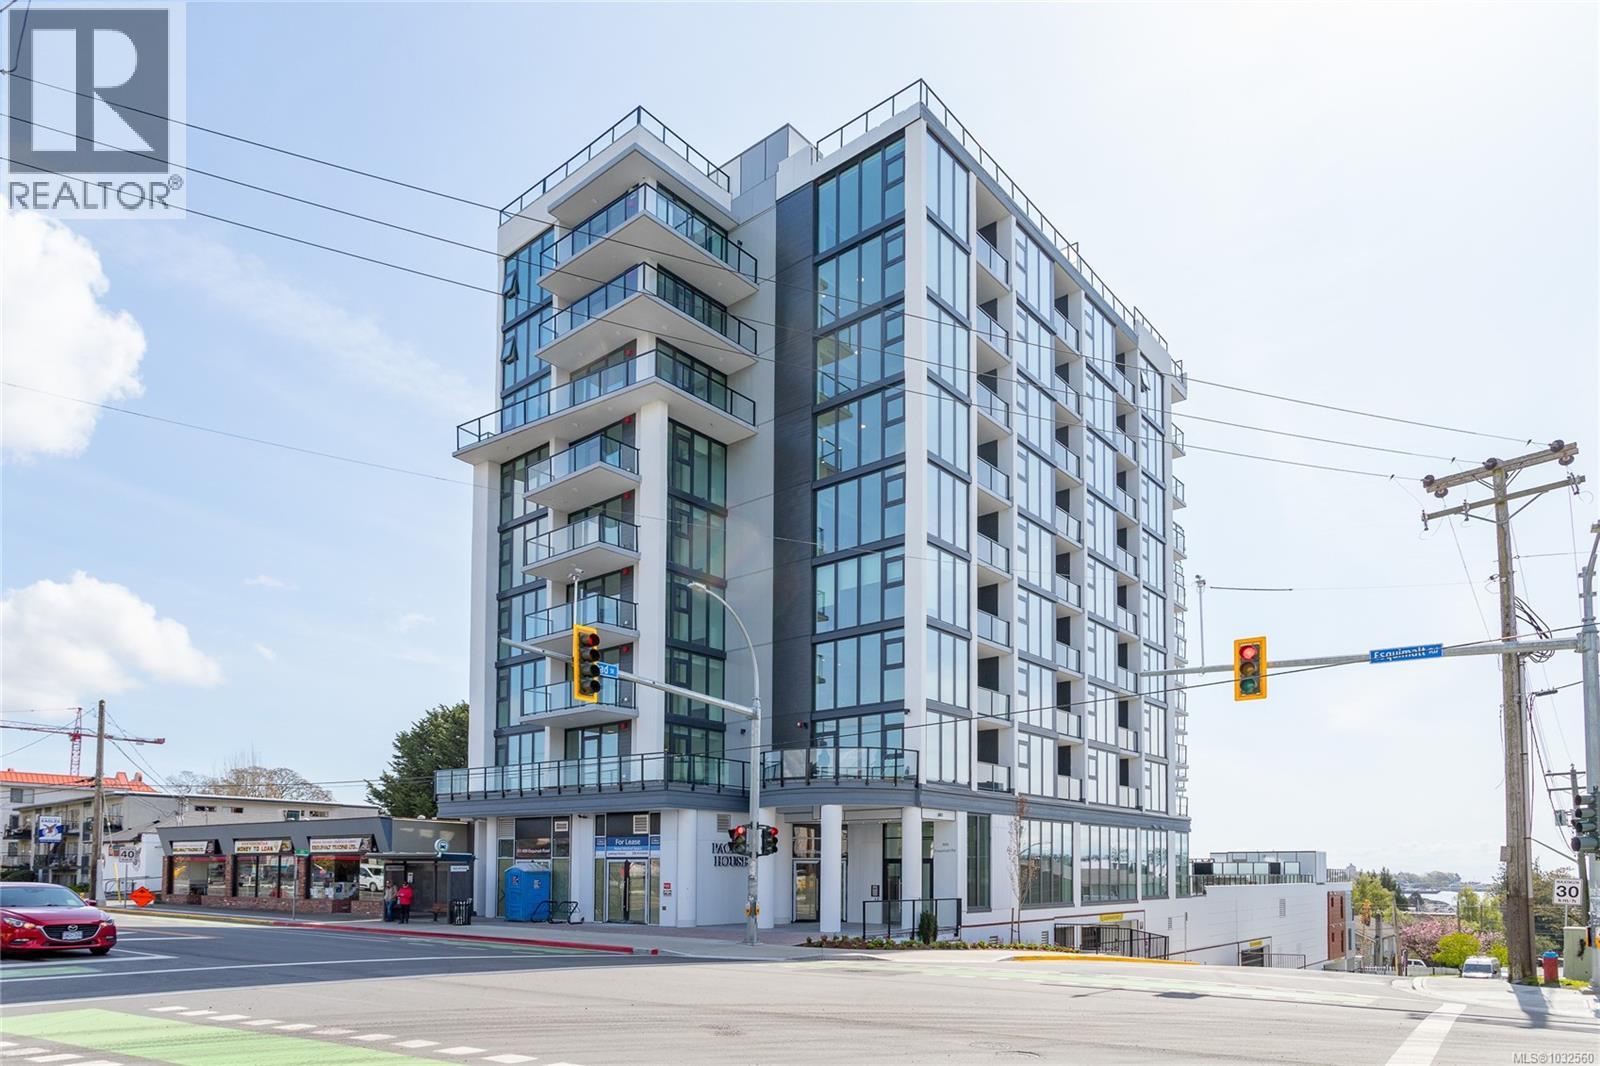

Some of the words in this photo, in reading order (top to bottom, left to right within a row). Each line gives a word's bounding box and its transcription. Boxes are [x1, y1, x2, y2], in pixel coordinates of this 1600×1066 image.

[1374, 646, 1426, 661] Esquimalt
[615, 838, 624, 846] For
[625, 838, 641, 846] Lease
[121, 850, 135, 858] 40
[714, 855, 749, 867] HOUSE
[1556, 885, 1579, 898] 30
